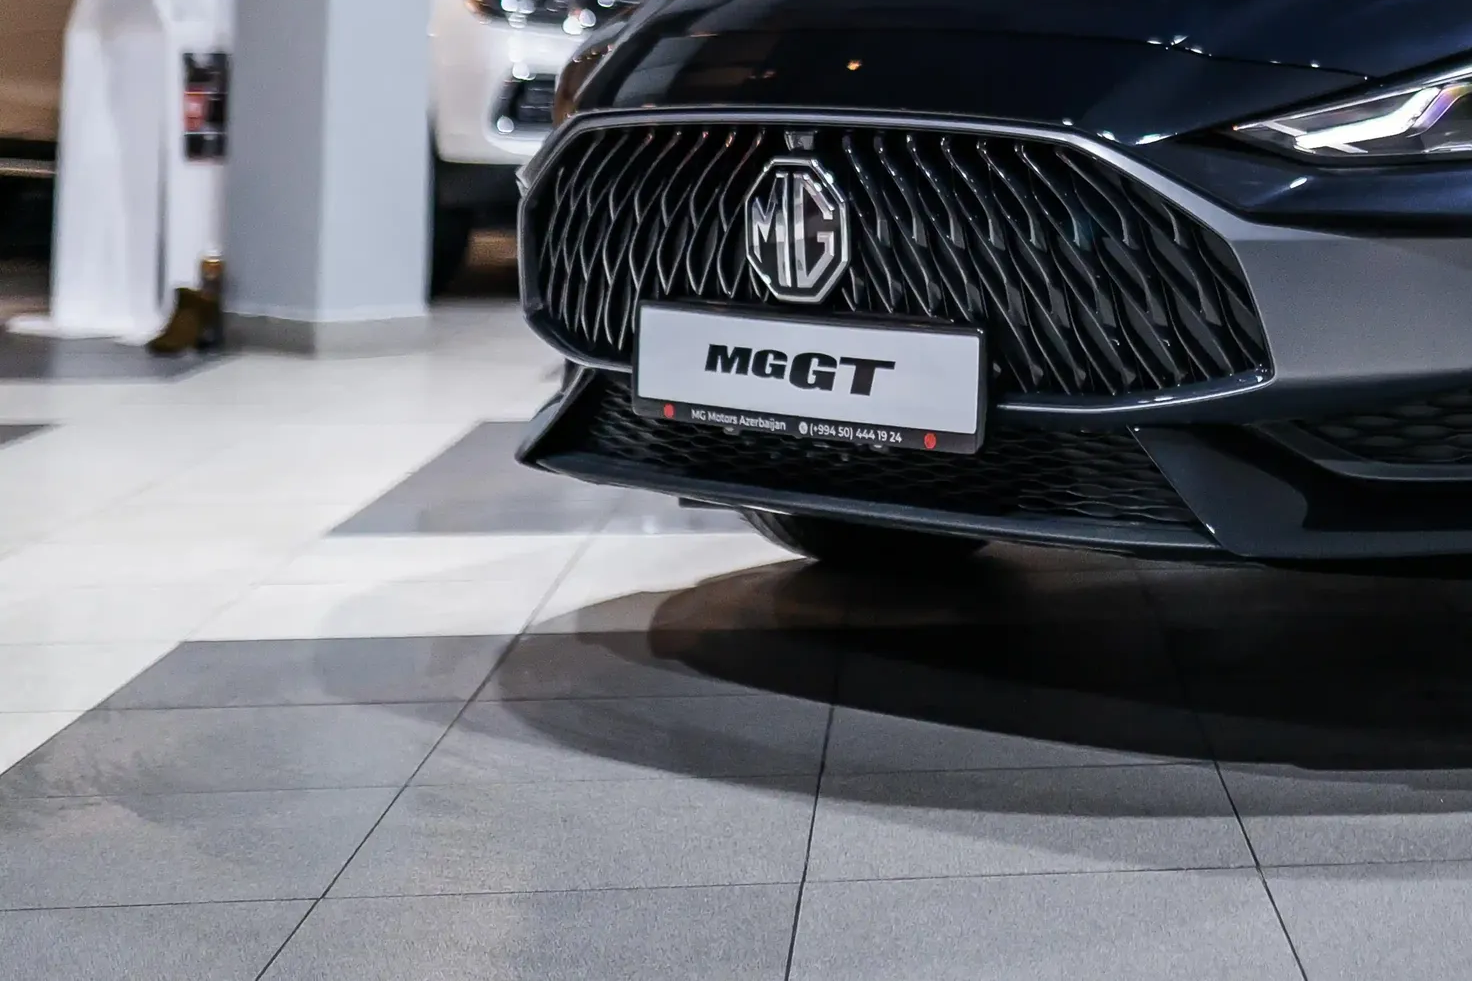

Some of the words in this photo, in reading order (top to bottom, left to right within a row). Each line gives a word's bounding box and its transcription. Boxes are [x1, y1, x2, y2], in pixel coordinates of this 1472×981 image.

[752, 171, 836, 289] MG
[691, 409, 706, 421] MG
[708, 411, 738, 425] Motors
[739, 415, 787, 432] Azerbaijan
[838, 426, 853, 440] 50)
[855, 428, 876, 440] 444
[877, 429, 888, 441] 19
[889, 431, 903, 443] 24
